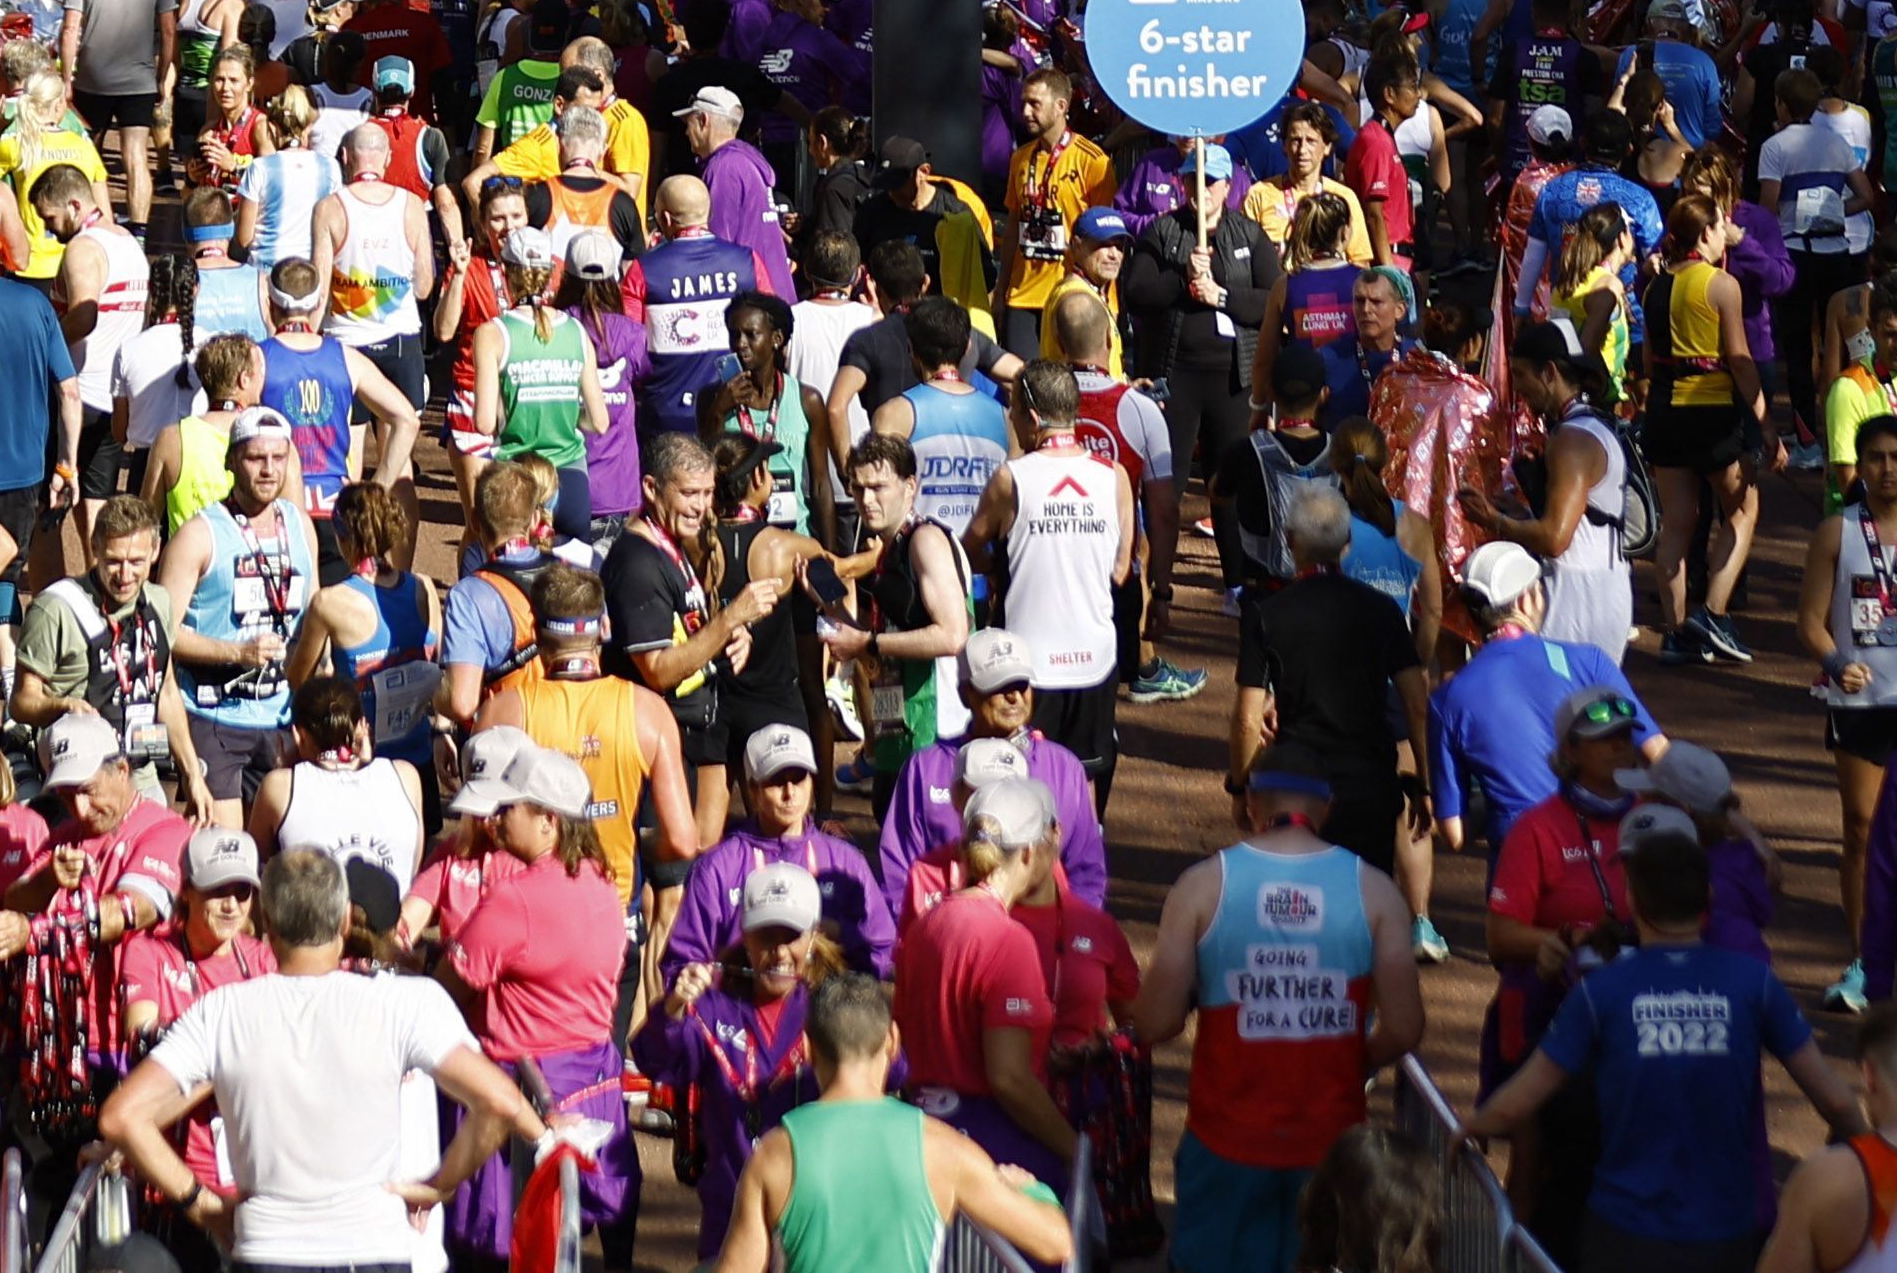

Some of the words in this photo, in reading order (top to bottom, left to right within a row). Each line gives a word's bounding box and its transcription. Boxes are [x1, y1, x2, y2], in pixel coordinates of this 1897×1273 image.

[1139, 19, 1251, 53] 6-star
[1126, 63, 1266, 98] finisher
[1520, 77, 1566, 104] tsa
[671, 272, 737, 298] JAMES
[1303, 321, 1330, 331] LUNG
[1332, 321, 1346, 330] UK
[298, 378, 320, 414] 100
[921, 455, 984, 478] JDRF
[1044, 503, 1077, 518] HOME
[1082, 502, 1094, 517] IS
[1029, 519, 1106, 535] EVERYTHING
[1049, 651, 1092, 666] SHELTER
[1254, 949, 1308, 966] GOING
[1238, 974, 1335, 1000] FURTHER
[1246, 1012, 1275, 1029] FOR
[1280, 1019, 1291, 1029] A
[1633, 1003, 1728, 1021] FINISHER
[1637, 1022, 1729, 1055] 2022
